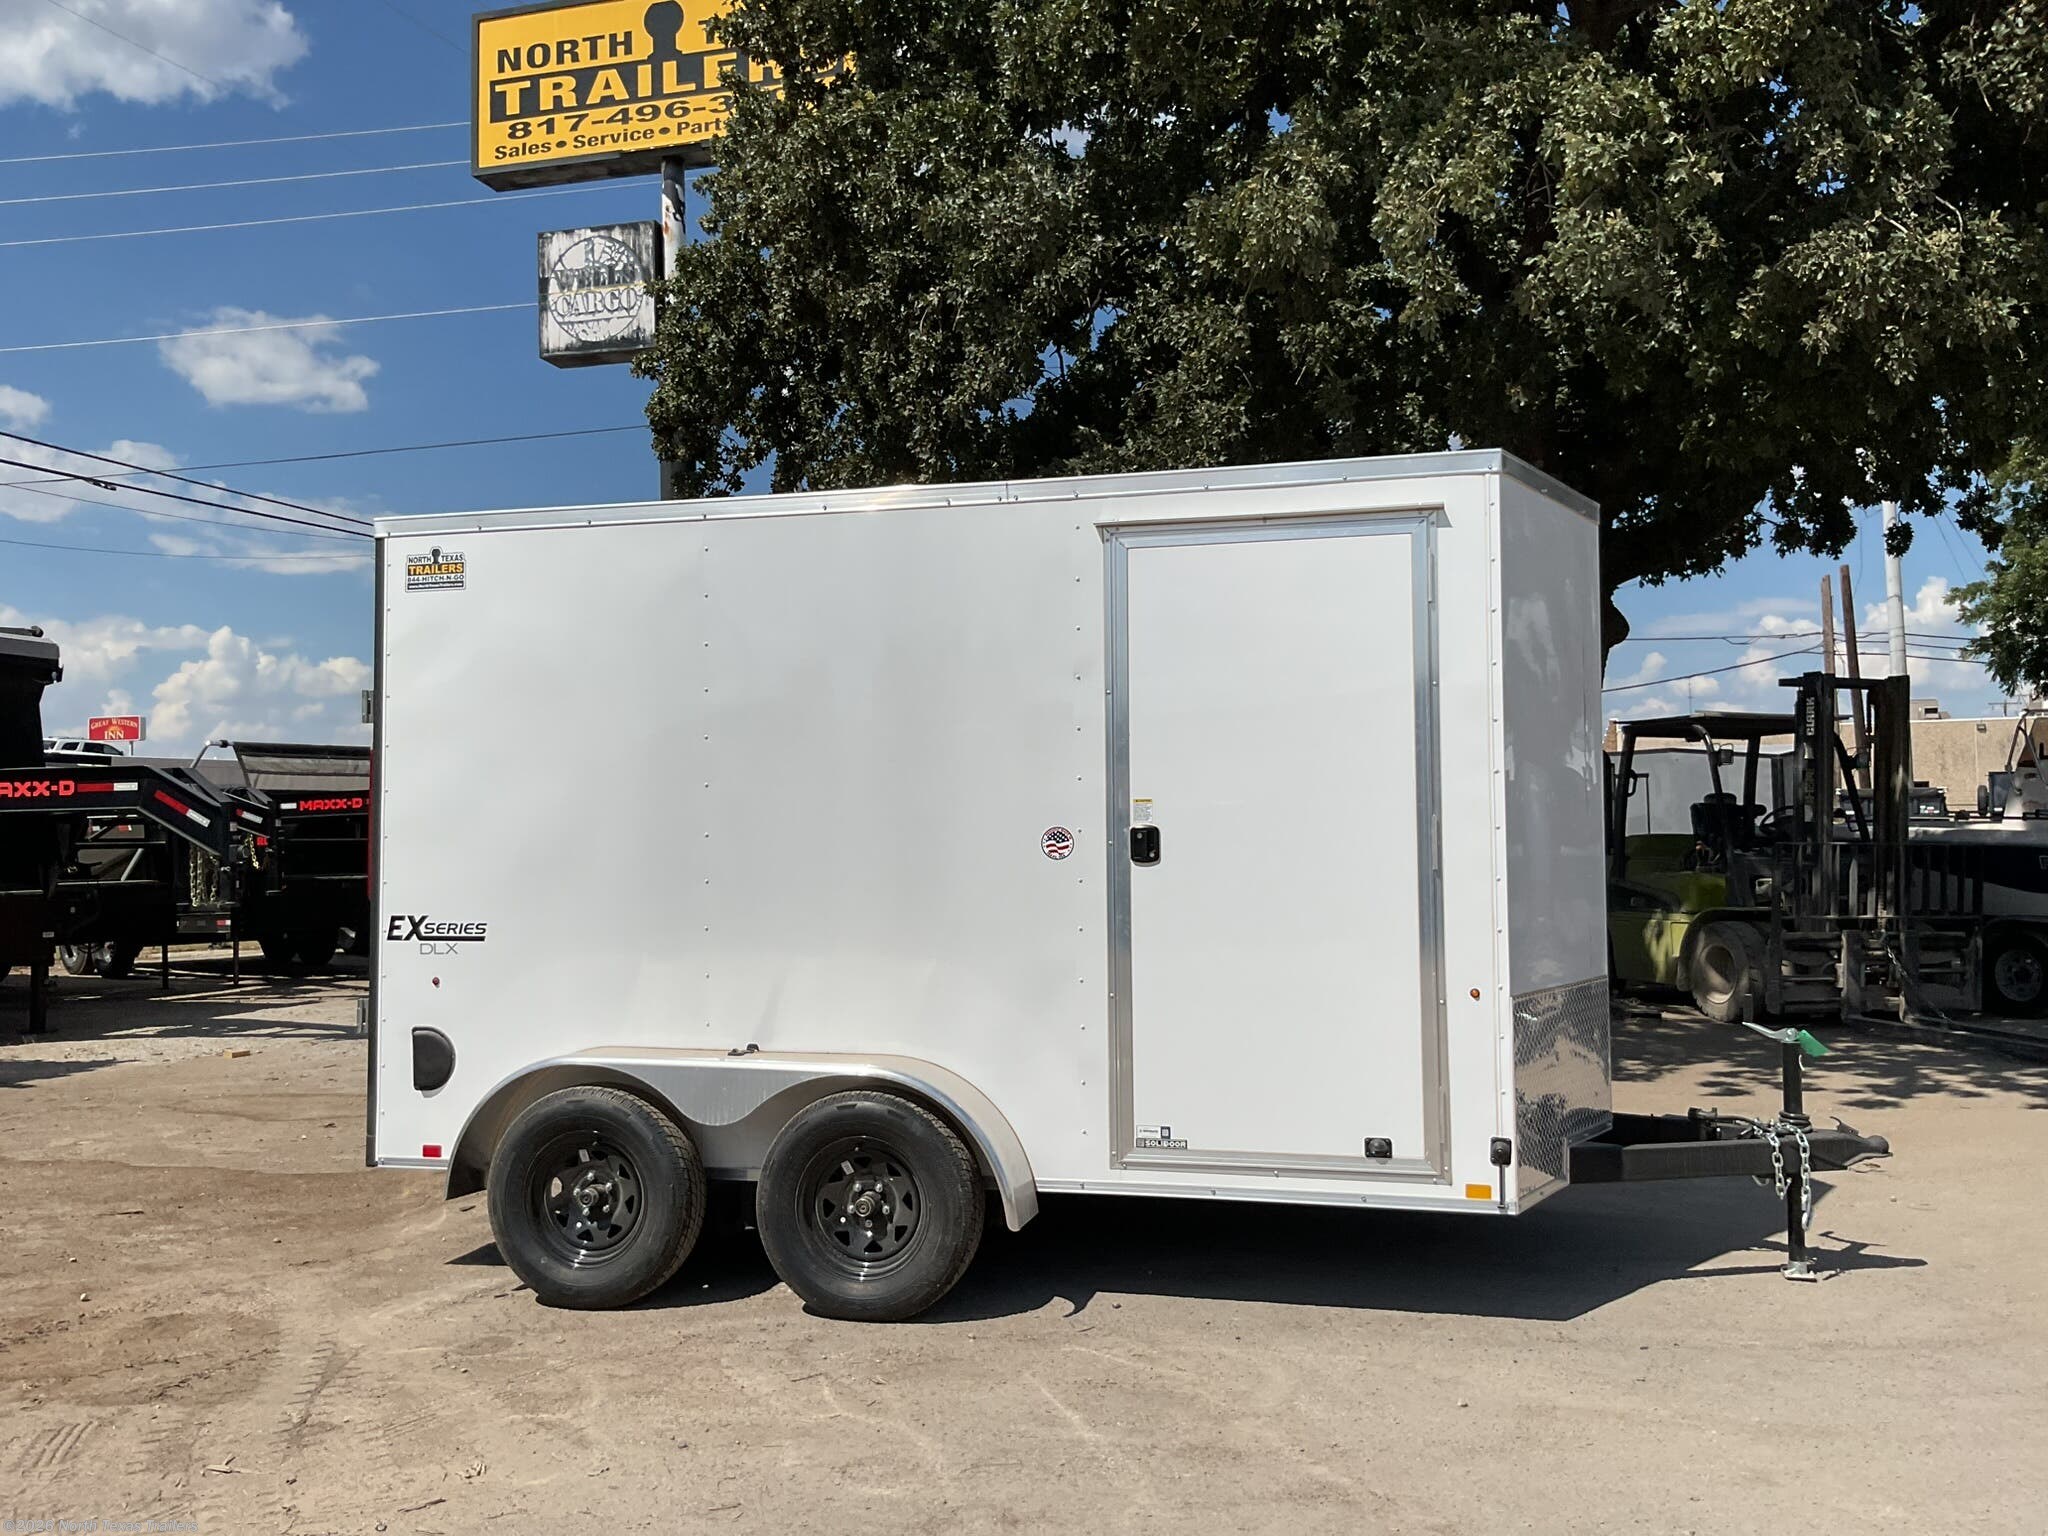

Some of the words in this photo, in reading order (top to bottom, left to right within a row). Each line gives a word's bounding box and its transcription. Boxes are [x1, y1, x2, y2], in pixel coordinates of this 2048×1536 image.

[497, 31, 632, 73] NORTH
[494, 142, 552, 160] Sales
[573, 129, 655, 149] Service
[553, 287, 638, 318] CARGO
[408, 556, 431, 564] NORTH
[441, 553, 463, 562] TEXAS
[409, 563, 463, 575] TRAILERS
[112, 717, 138, 728] WESTERN
[1806, 697, 1815, 736] CLARK
[104, 730, 124, 740] INN
[0, 781, 75, 797] AXX-D
[300, 798, 362, 811] MAXX-D
[420, 943, 458, 955] DLX
